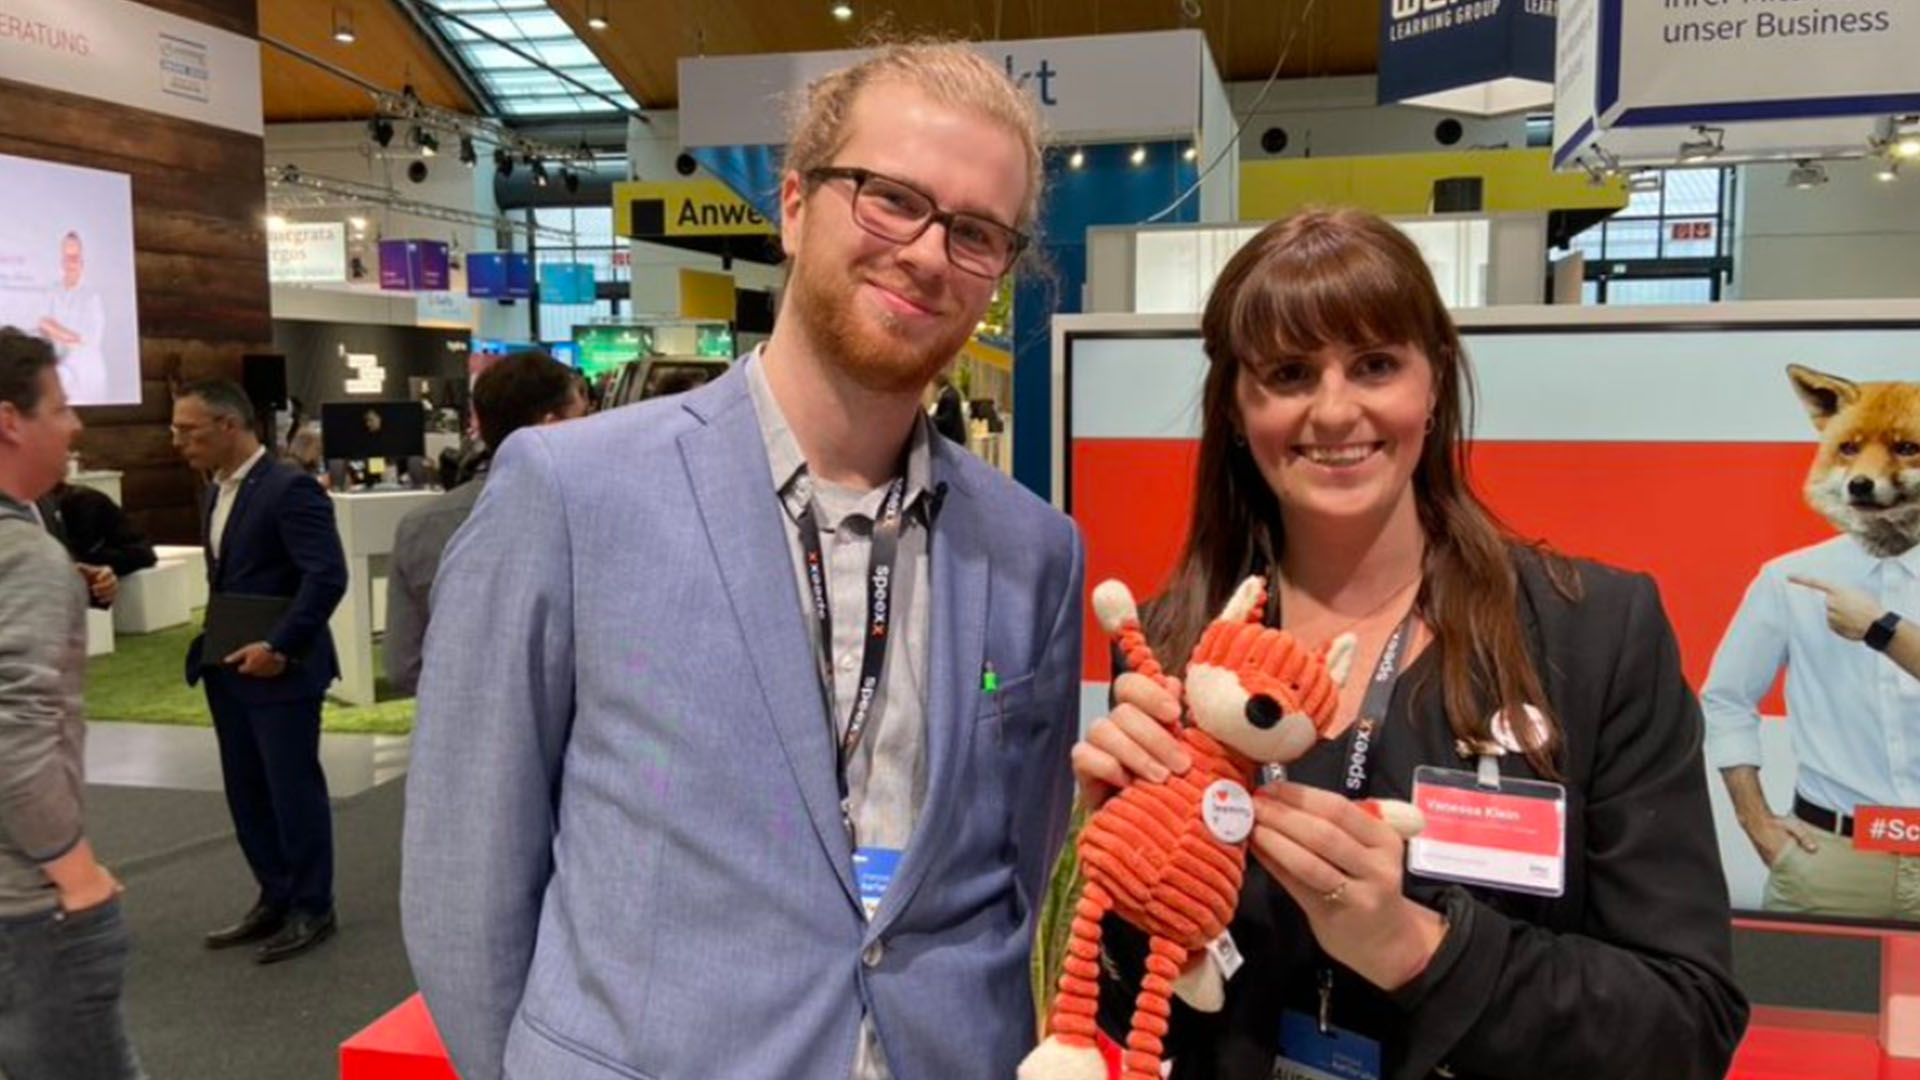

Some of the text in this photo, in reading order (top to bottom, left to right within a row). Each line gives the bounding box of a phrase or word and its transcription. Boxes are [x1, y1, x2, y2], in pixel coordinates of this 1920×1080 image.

[1389, 10, 1452, 42] LEARNING
[1455, 0, 1500, 25] GROUP
[1663, 9, 1890, 44] unser Business
[870, 564, 891, 638] speexx
[843, 676, 877, 744] speexx
[1345, 717, 1375, 791] speexx
[1426, 798, 1522, 822] Vanessa Klein
[1868, 816, 1920, 842] #Sc
